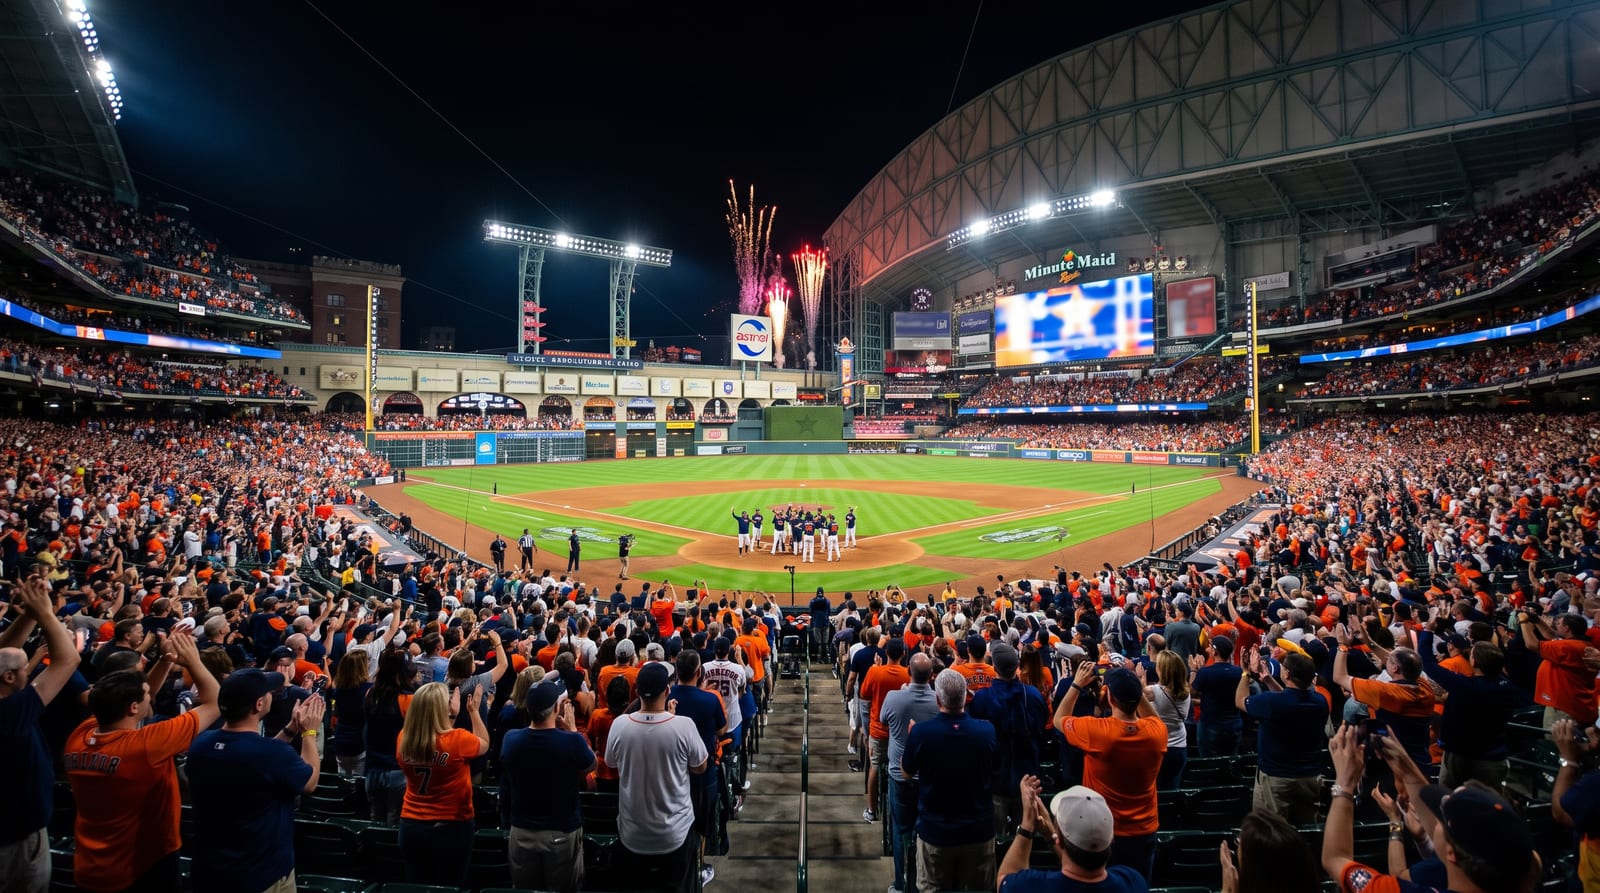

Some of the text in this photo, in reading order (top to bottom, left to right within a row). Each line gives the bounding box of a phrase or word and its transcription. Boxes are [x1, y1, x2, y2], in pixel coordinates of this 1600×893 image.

[1024, 261, 1074, 281] Minute
[1077, 252, 1115, 268] Maid
[413, 766, 432, 794] 7
